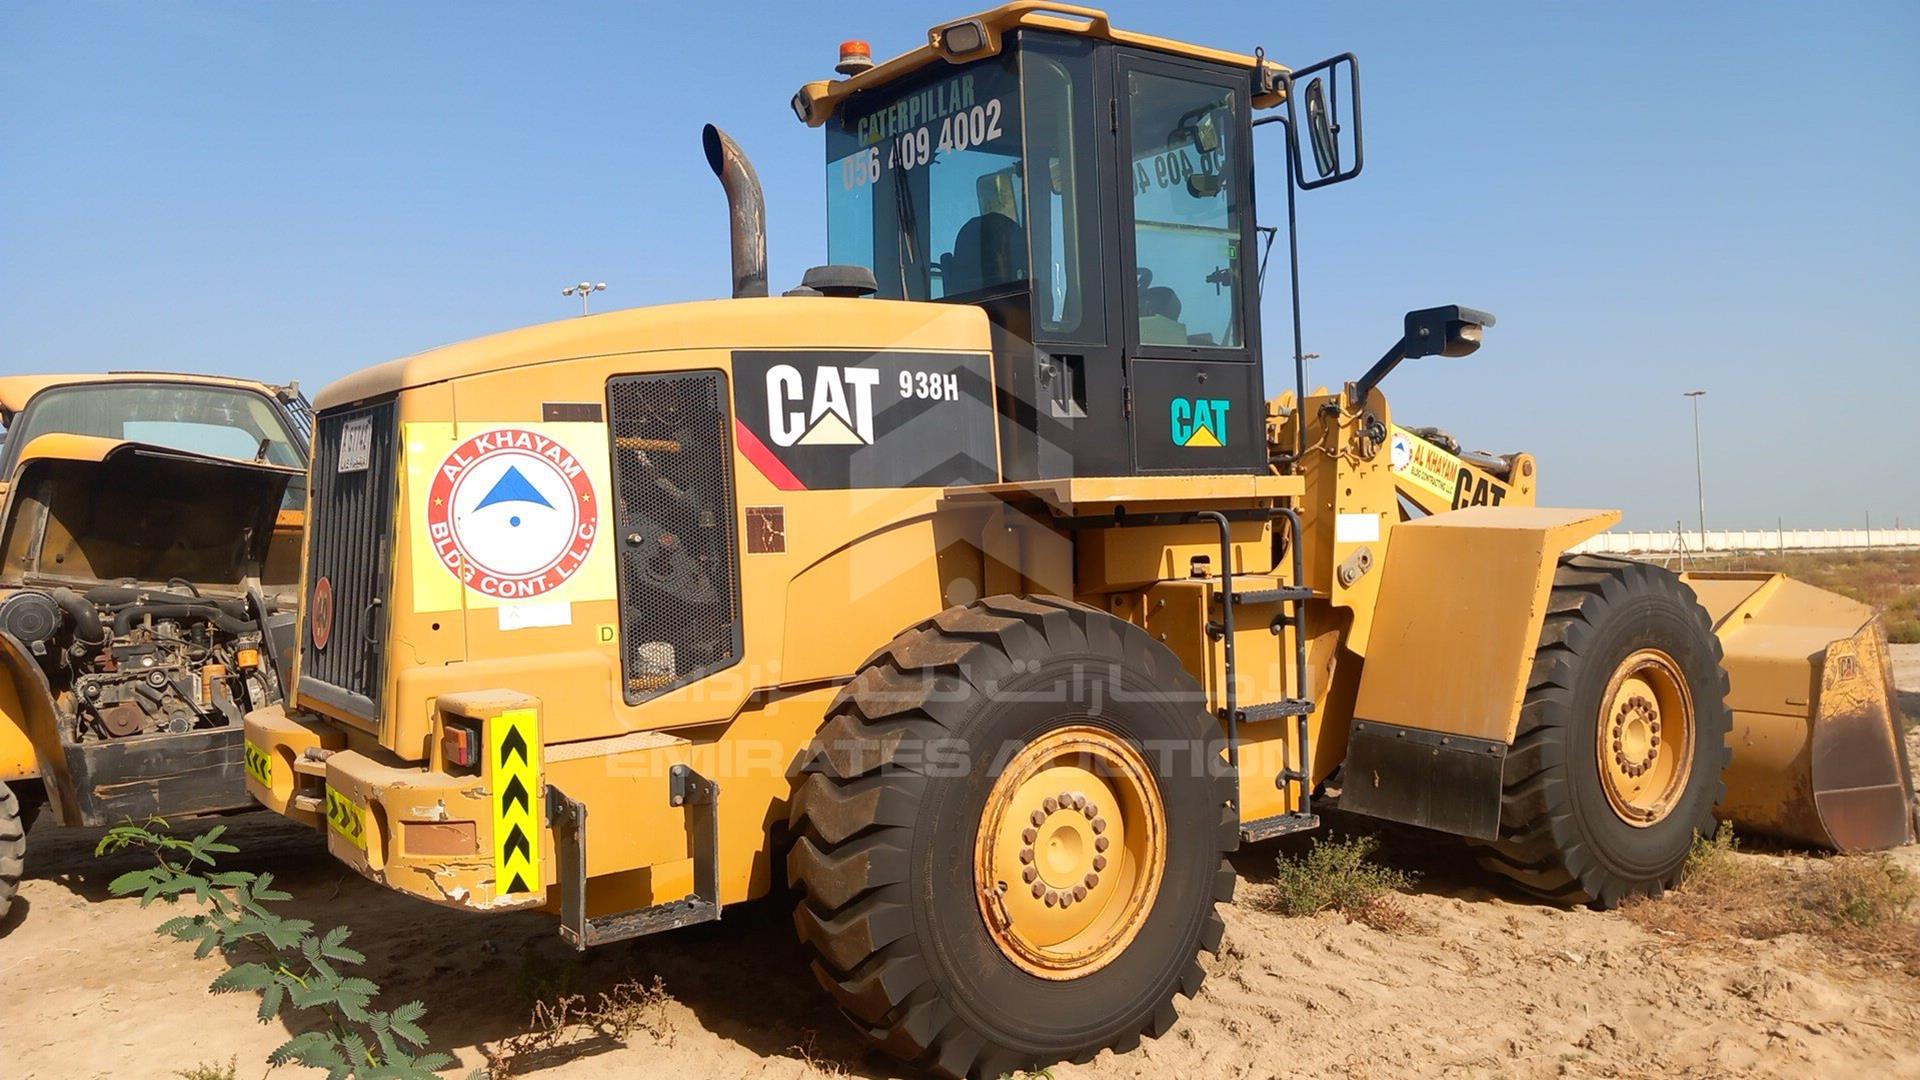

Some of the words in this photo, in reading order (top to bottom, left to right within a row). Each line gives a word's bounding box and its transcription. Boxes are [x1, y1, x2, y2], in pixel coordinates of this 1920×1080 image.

[858, 74, 975, 148] CATERPILLAR
[842, 146, 880, 191] 056
[888, 126, 930, 171] 409
[938, 98, 1002, 154] 4002
[766, 364, 880, 447] CAT
[899, 370, 959, 401] 938H
[1171, 398, 1230, 447] CAT
[442, 453, 474, 484] AL
[475, 431, 582, 480] KHAYAM
[1413, 444, 1424, 466] AL
[1425, 449, 1458, 482] KHAYAM
[1451, 467, 1507, 511] CAT
[431, 521, 476, 584] BLDG
[480, 576, 554, 597] CONT.
[557, 516, 597, 580] L.L.C.
[601, 626, 614, 643] D
